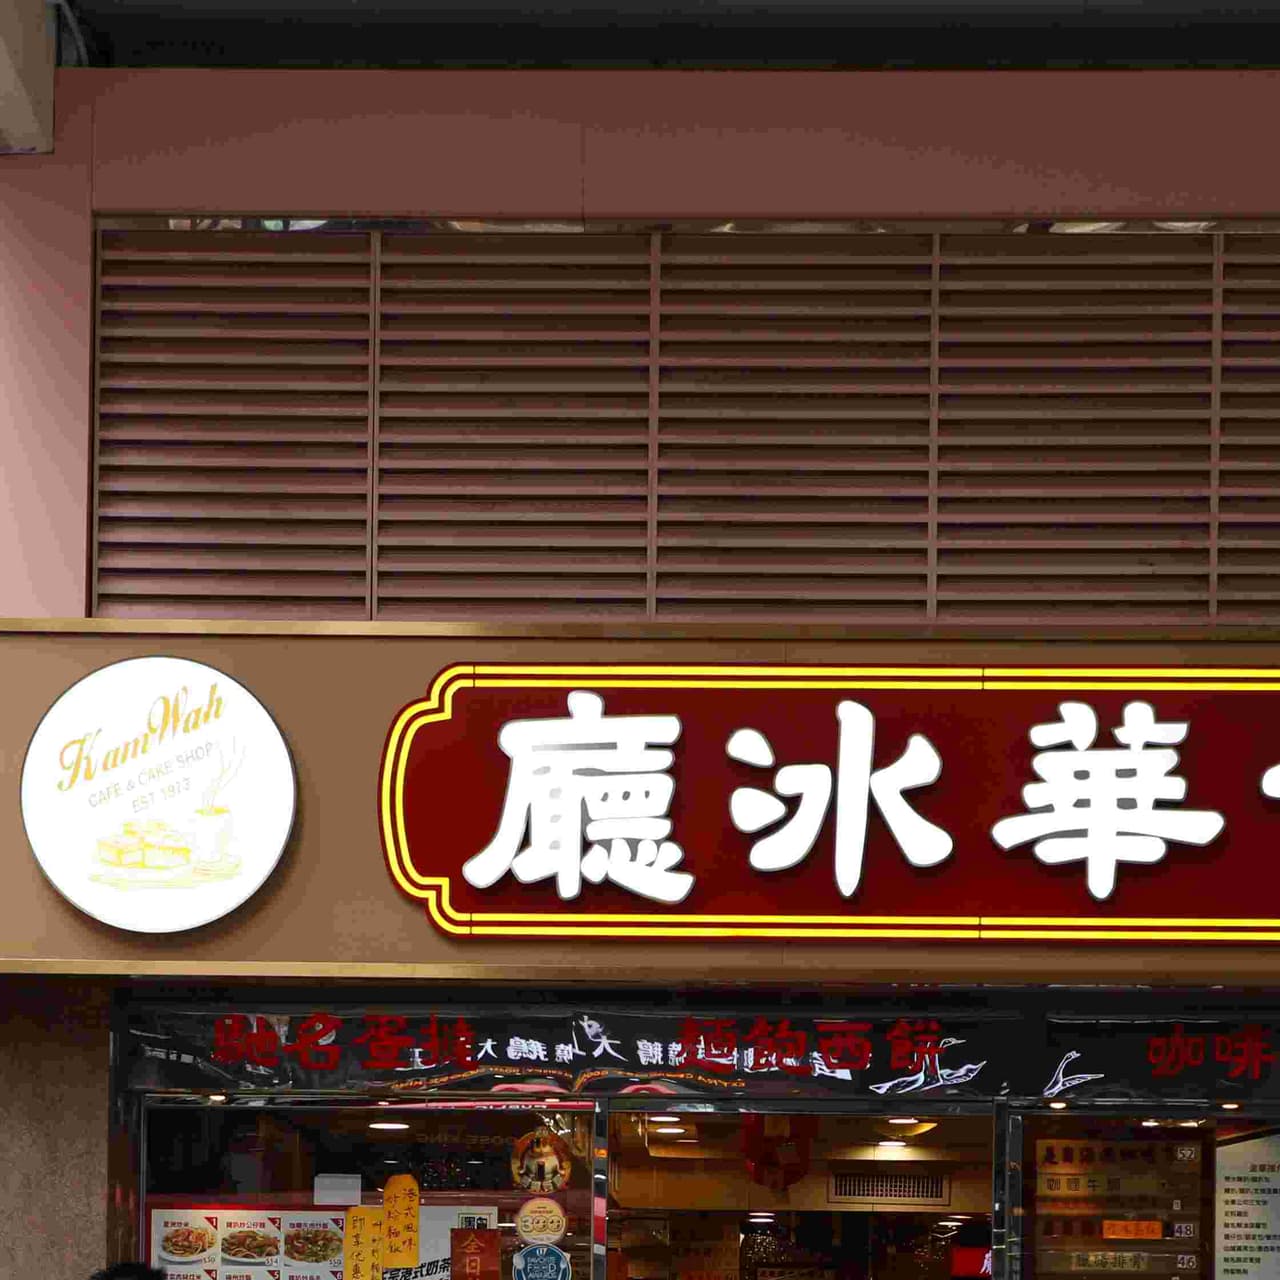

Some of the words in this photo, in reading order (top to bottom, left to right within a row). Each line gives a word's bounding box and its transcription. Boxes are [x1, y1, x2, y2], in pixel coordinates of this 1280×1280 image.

[56, 728, 150, 792] Kam
[147, 682, 224, 746] Wah
[176, 741, 214, 767] SHOP
[1178, 1148, 1195, 1160] 52
[1176, 1225, 1193, 1236] 48
